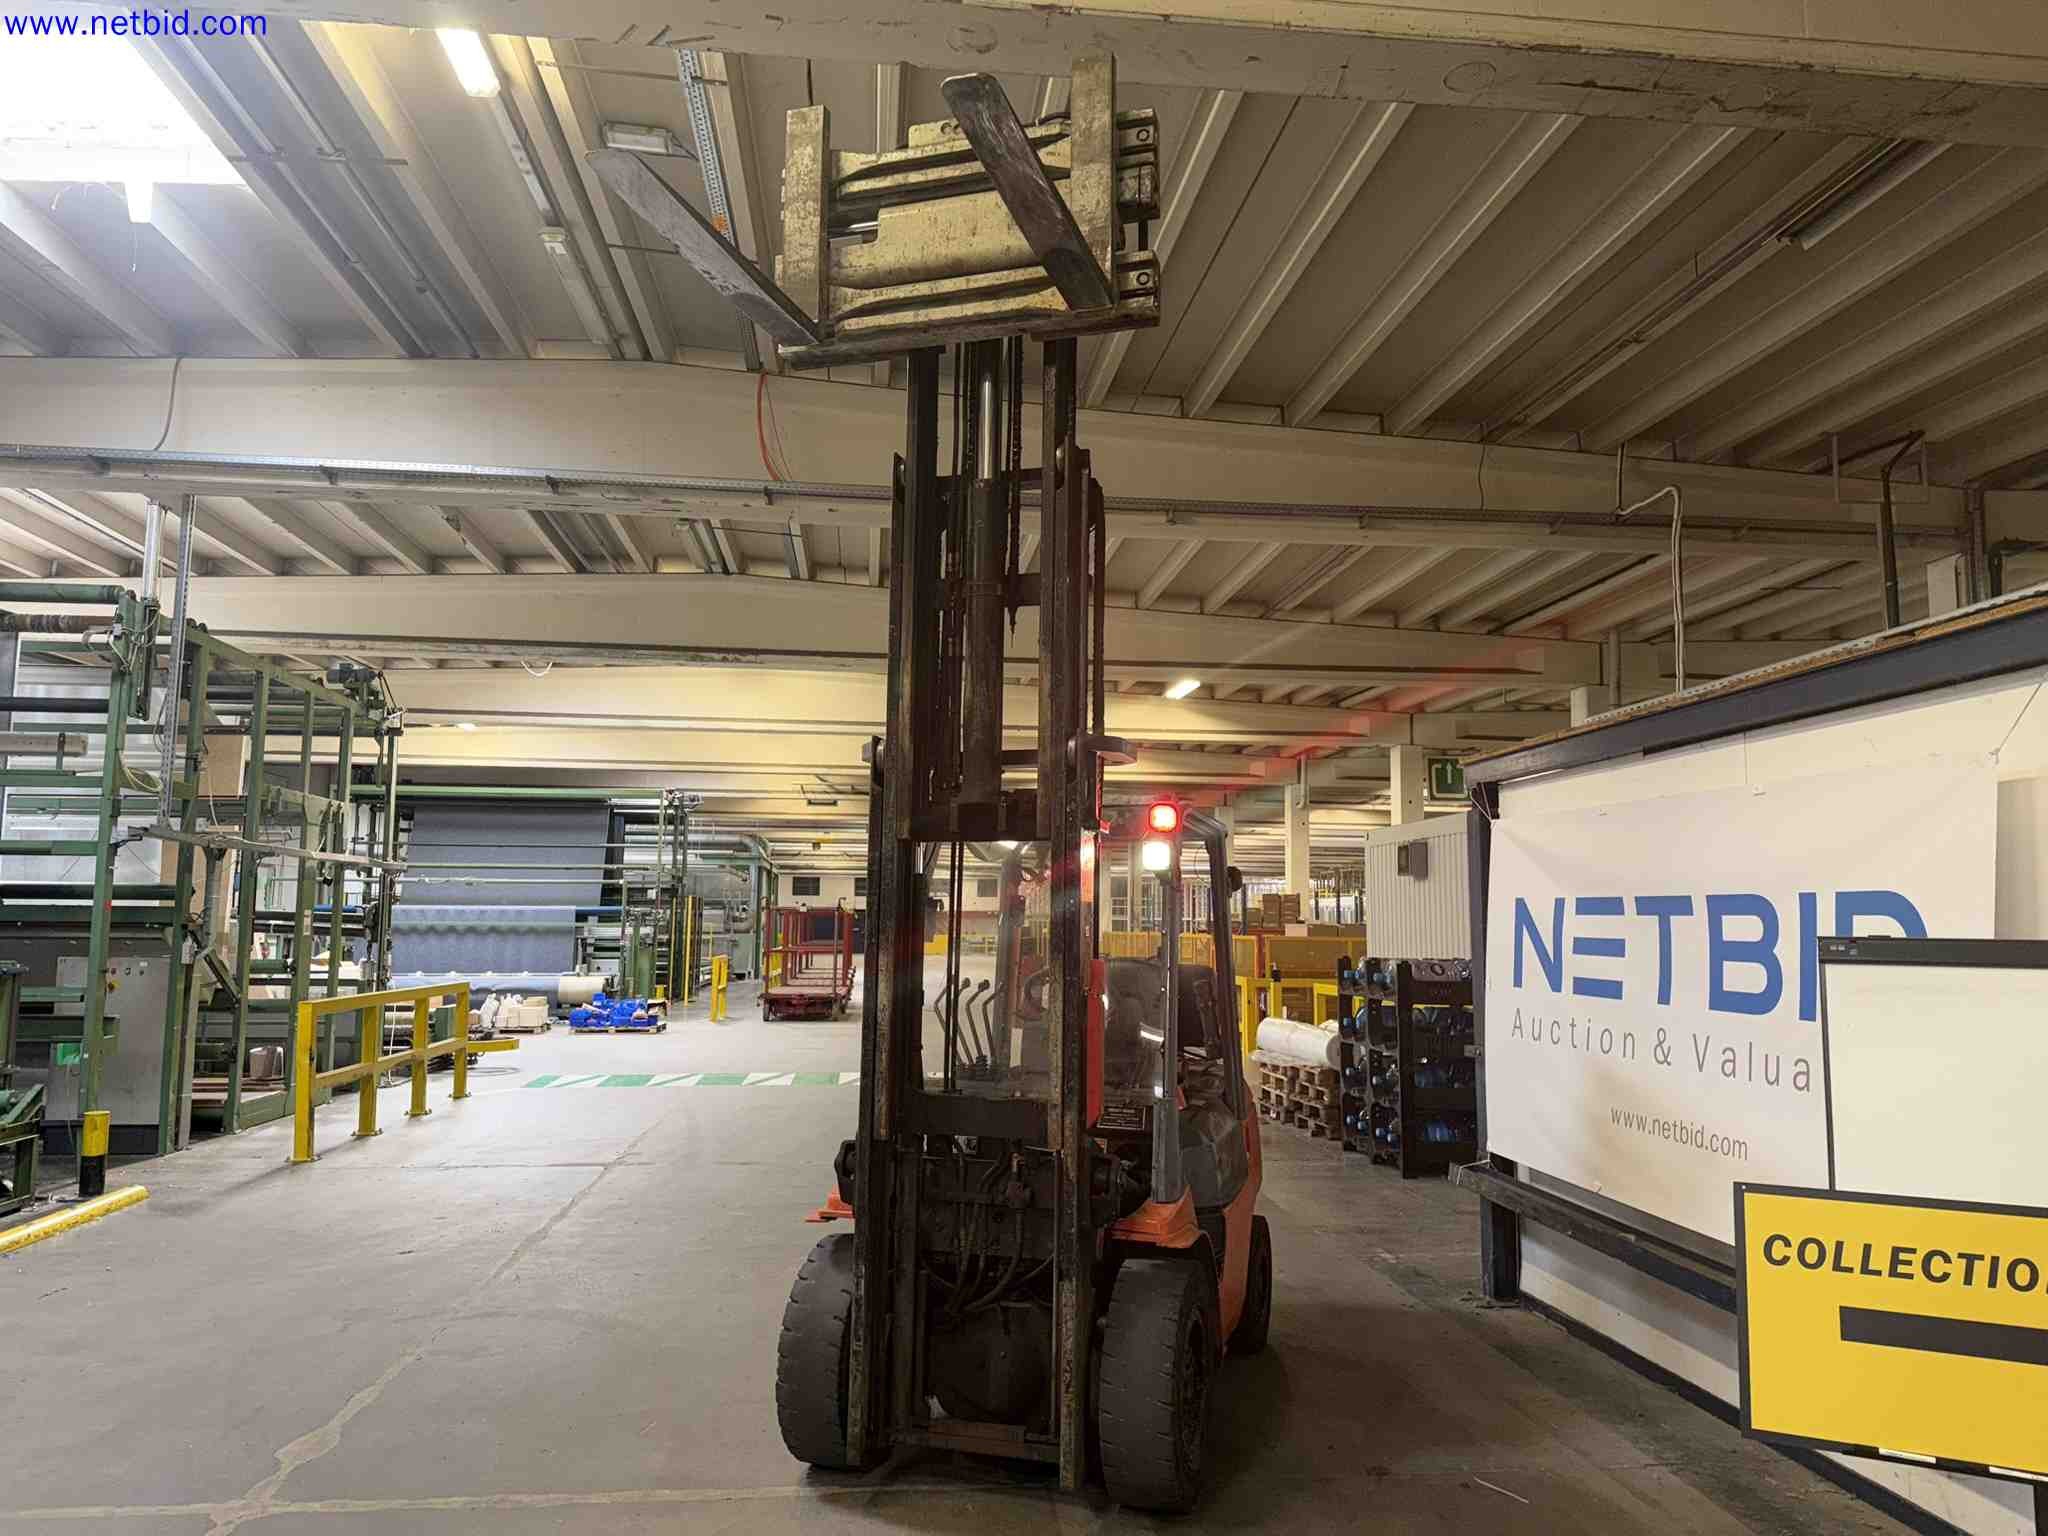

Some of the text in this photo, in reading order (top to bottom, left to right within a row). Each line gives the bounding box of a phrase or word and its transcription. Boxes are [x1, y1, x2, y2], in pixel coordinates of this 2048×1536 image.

[1511, 1006, 1811, 1094] Auction & Valua
[1610, 1106, 1749, 1161] www.netbid.com
[1763, 1233, 2048, 1295] COLLECTIO
